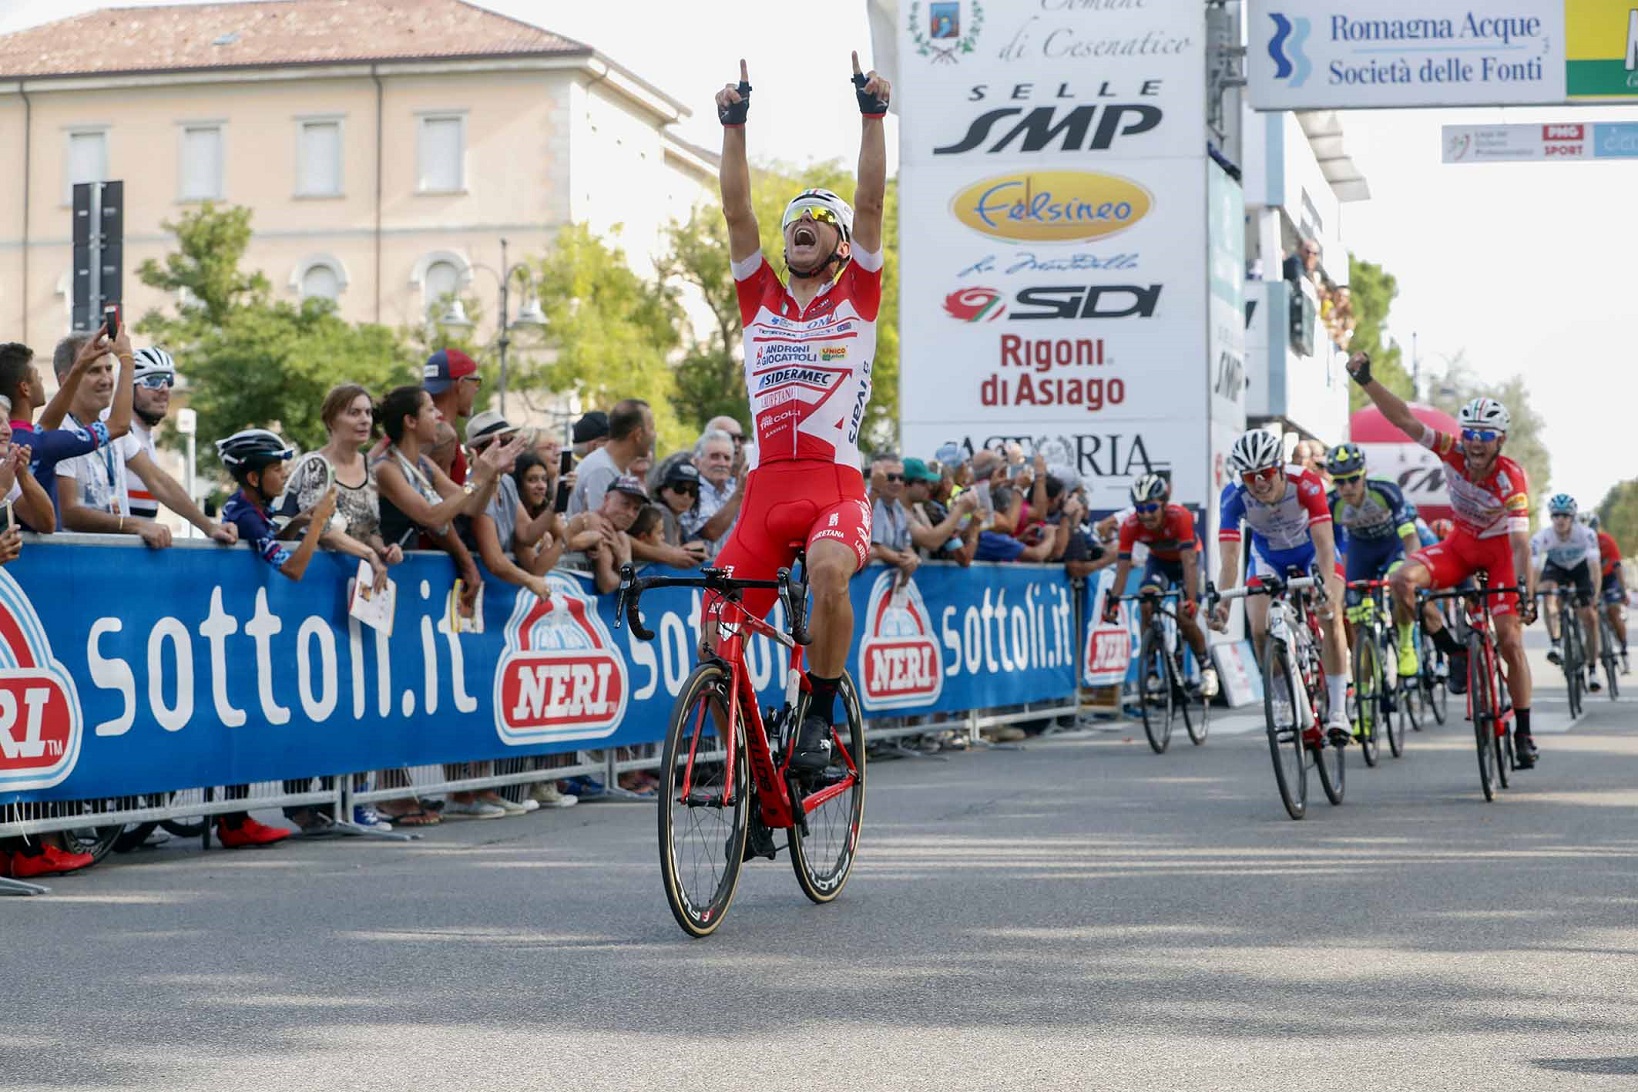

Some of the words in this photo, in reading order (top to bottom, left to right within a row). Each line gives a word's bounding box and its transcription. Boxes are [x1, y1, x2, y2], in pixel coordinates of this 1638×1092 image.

[1331, 14, 1454, 42] Romagna
[1458, 12, 1541, 44] Acque
[968, 79, 1163, 102] SELLE
[1328, 58, 1412, 86] Società
[1419, 57, 1474, 83] delle
[1481, 57, 1543, 82] Fonti
[933, 104, 1164, 155] SMP
[1544, 145, 1584, 157] SPORT
[974, 176, 1132, 228] Felsineo
[762, 353, 817, 366] GIOCATTOLI
[766, 344, 810, 354] ANDRONI
[1000, 334, 1105, 372] Rigoni
[765, 368, 831, 385] SIDERMEC
[981, 373, 1008, 406] di
[1015, 373, 1125, 411] Asiago
[942, 582, 1074, 677] sottoli.it
[870, 648, 936, 692] NERI
[512, 662, 613, 721] NERI
[0, 687, 50, 759] RI
